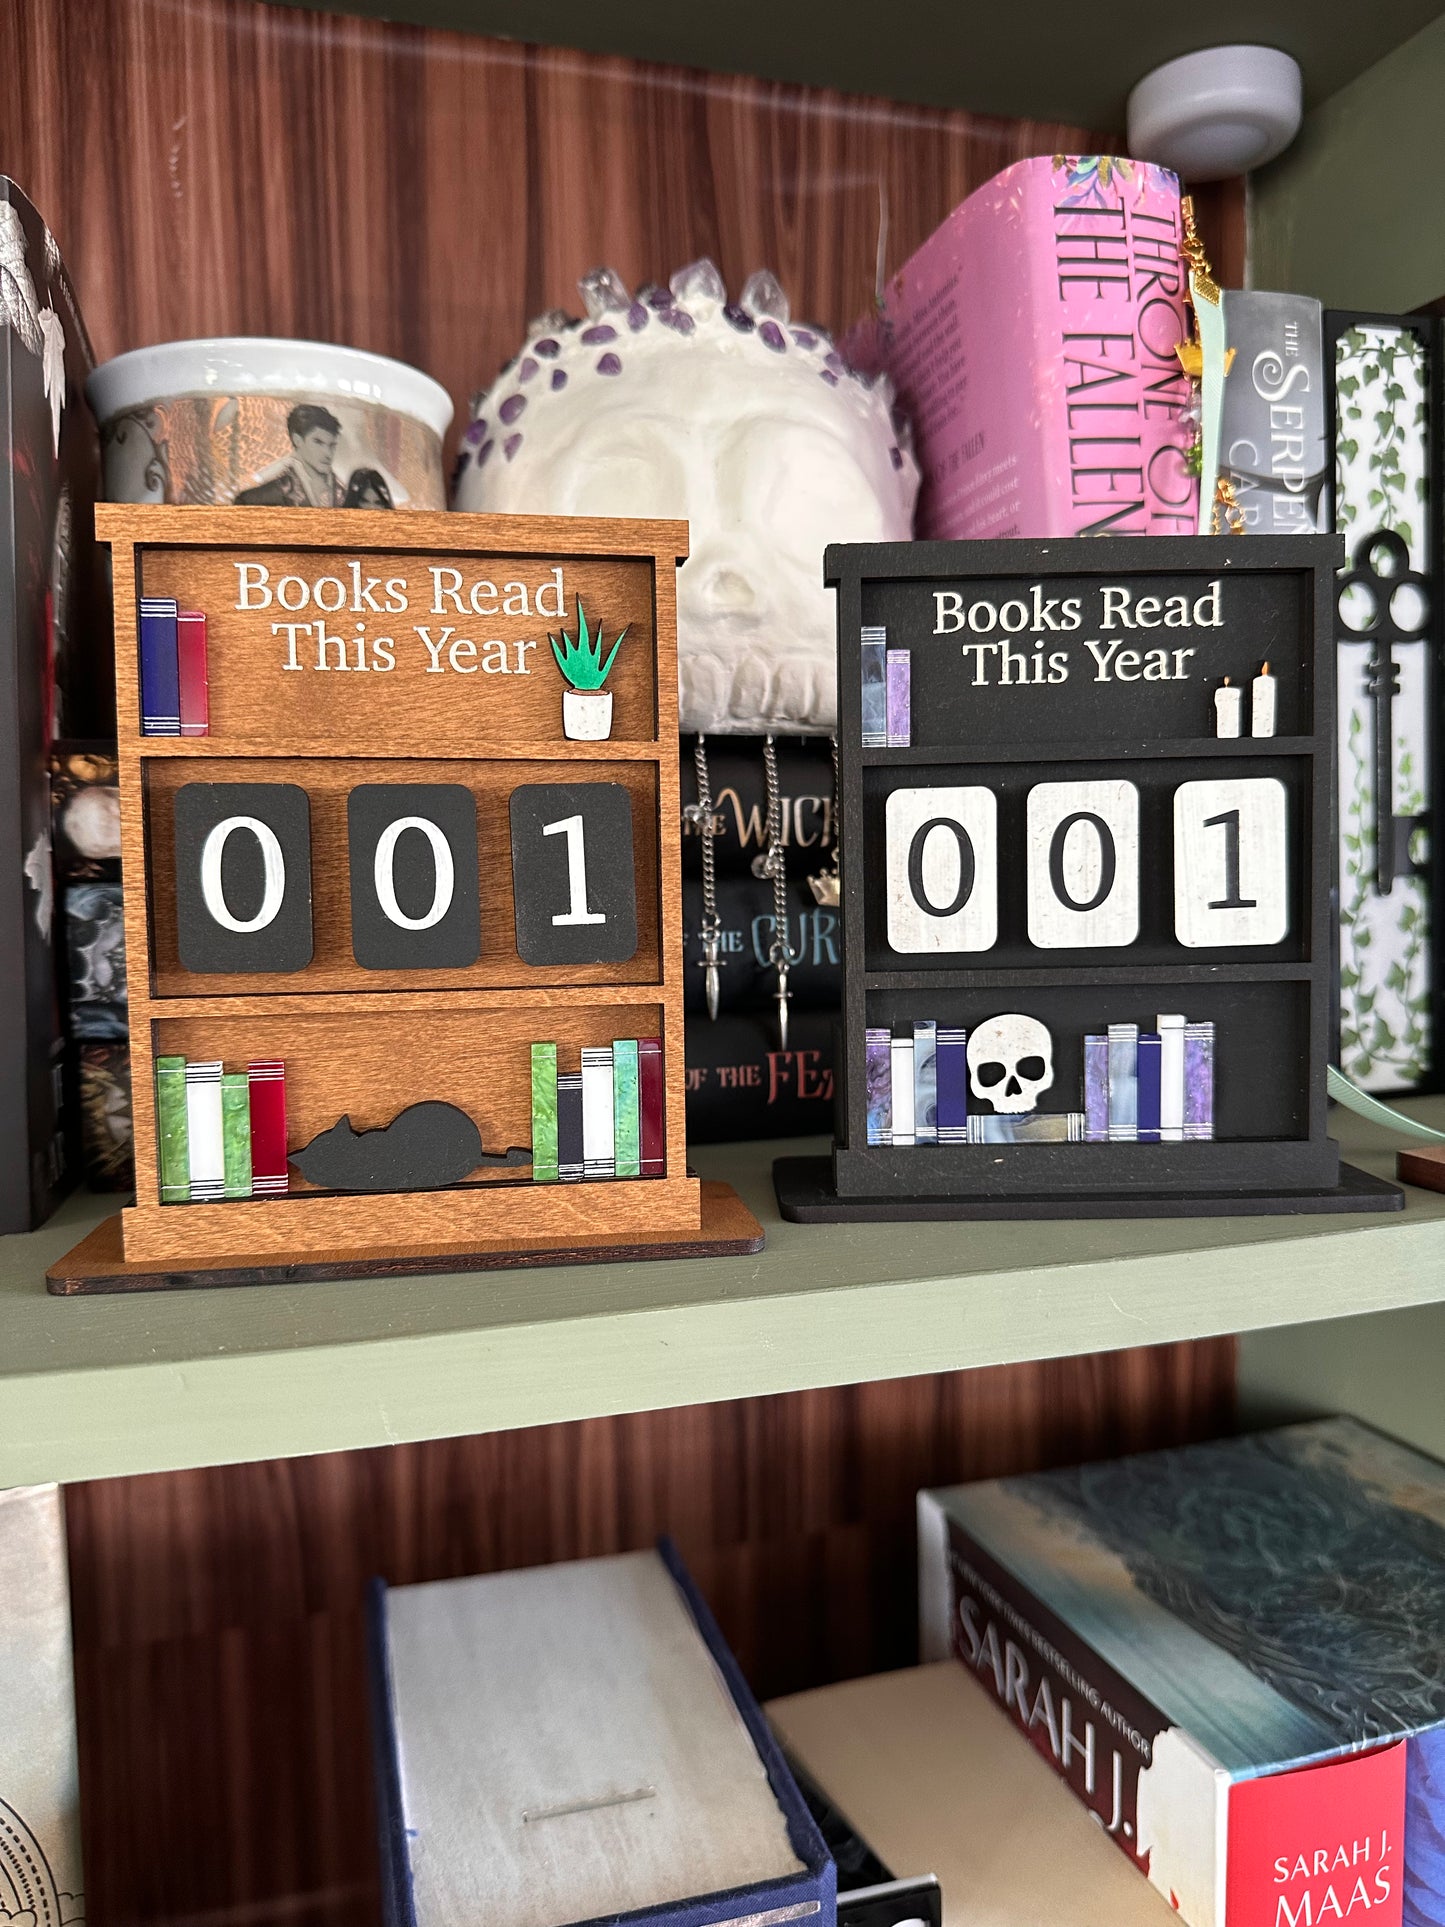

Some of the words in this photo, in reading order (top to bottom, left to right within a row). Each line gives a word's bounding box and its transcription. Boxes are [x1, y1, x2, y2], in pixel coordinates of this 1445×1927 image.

[1053, 197, 1131, 301] THE
[1130, 211, 1187, 420] THRONE
[1284, 321, 1299, 357] THE
[1062, 332, 1147, 537] FALLEN
[233, 562, 409, 615] Books
[429, 567, 569, 618] Read
[932, 586, 1081, 635] Books
[1098, 580, 1224, 631] Read
[271, 621, 397, 673] This
[413, 625, 537, 675] Year
[962, 640, 1069, 687] This
[1084, 639, 1194, 683] Year
[200, 815, 286, 934] 0
[374, 815, 455, 931] 0
[542, 814, 607, 927] 1
[907, 817, 976, 917] 0
[1048, 811, 1117, 912] 0
[1202, 809, 1257, 910] 1
[716, 1065, 761, 1088] THE
[959, 1596, 1095, 1795] SARAH
[1106, 1750, 1133, 1837] J.
[1100, 1700, 1151, 1760] AUTHOR
[1273, 1836, 1370, 1883] SARAH
[1378, 1829, 1392, 1862] J.
[1275, 1865, 1391, 1927] MAAS
